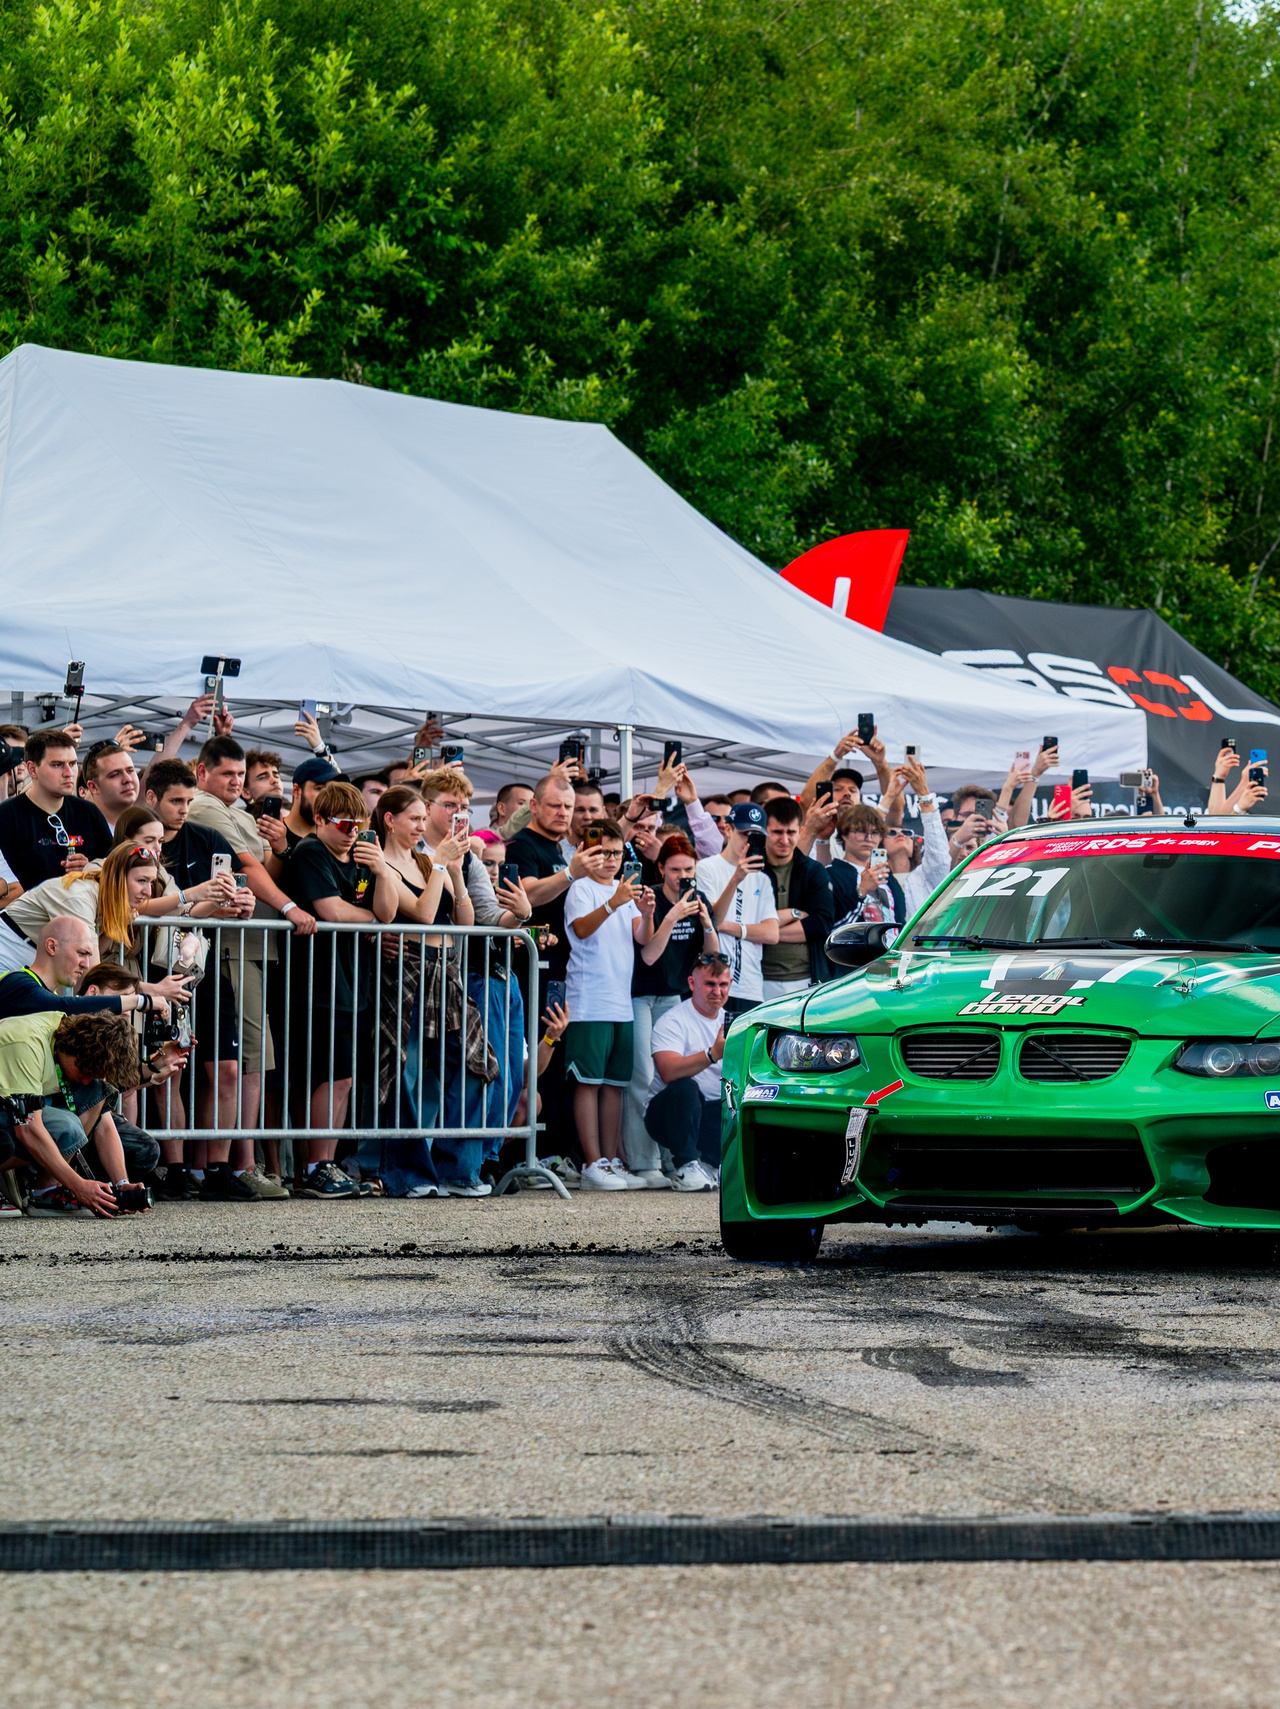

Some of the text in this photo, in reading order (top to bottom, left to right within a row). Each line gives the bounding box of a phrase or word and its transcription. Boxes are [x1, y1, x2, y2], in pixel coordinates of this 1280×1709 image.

[1082, 838, 1154, 851] RDS
[1178, 839, 1220, 847] OPEN
[953, 867, 1071, 899] 121
